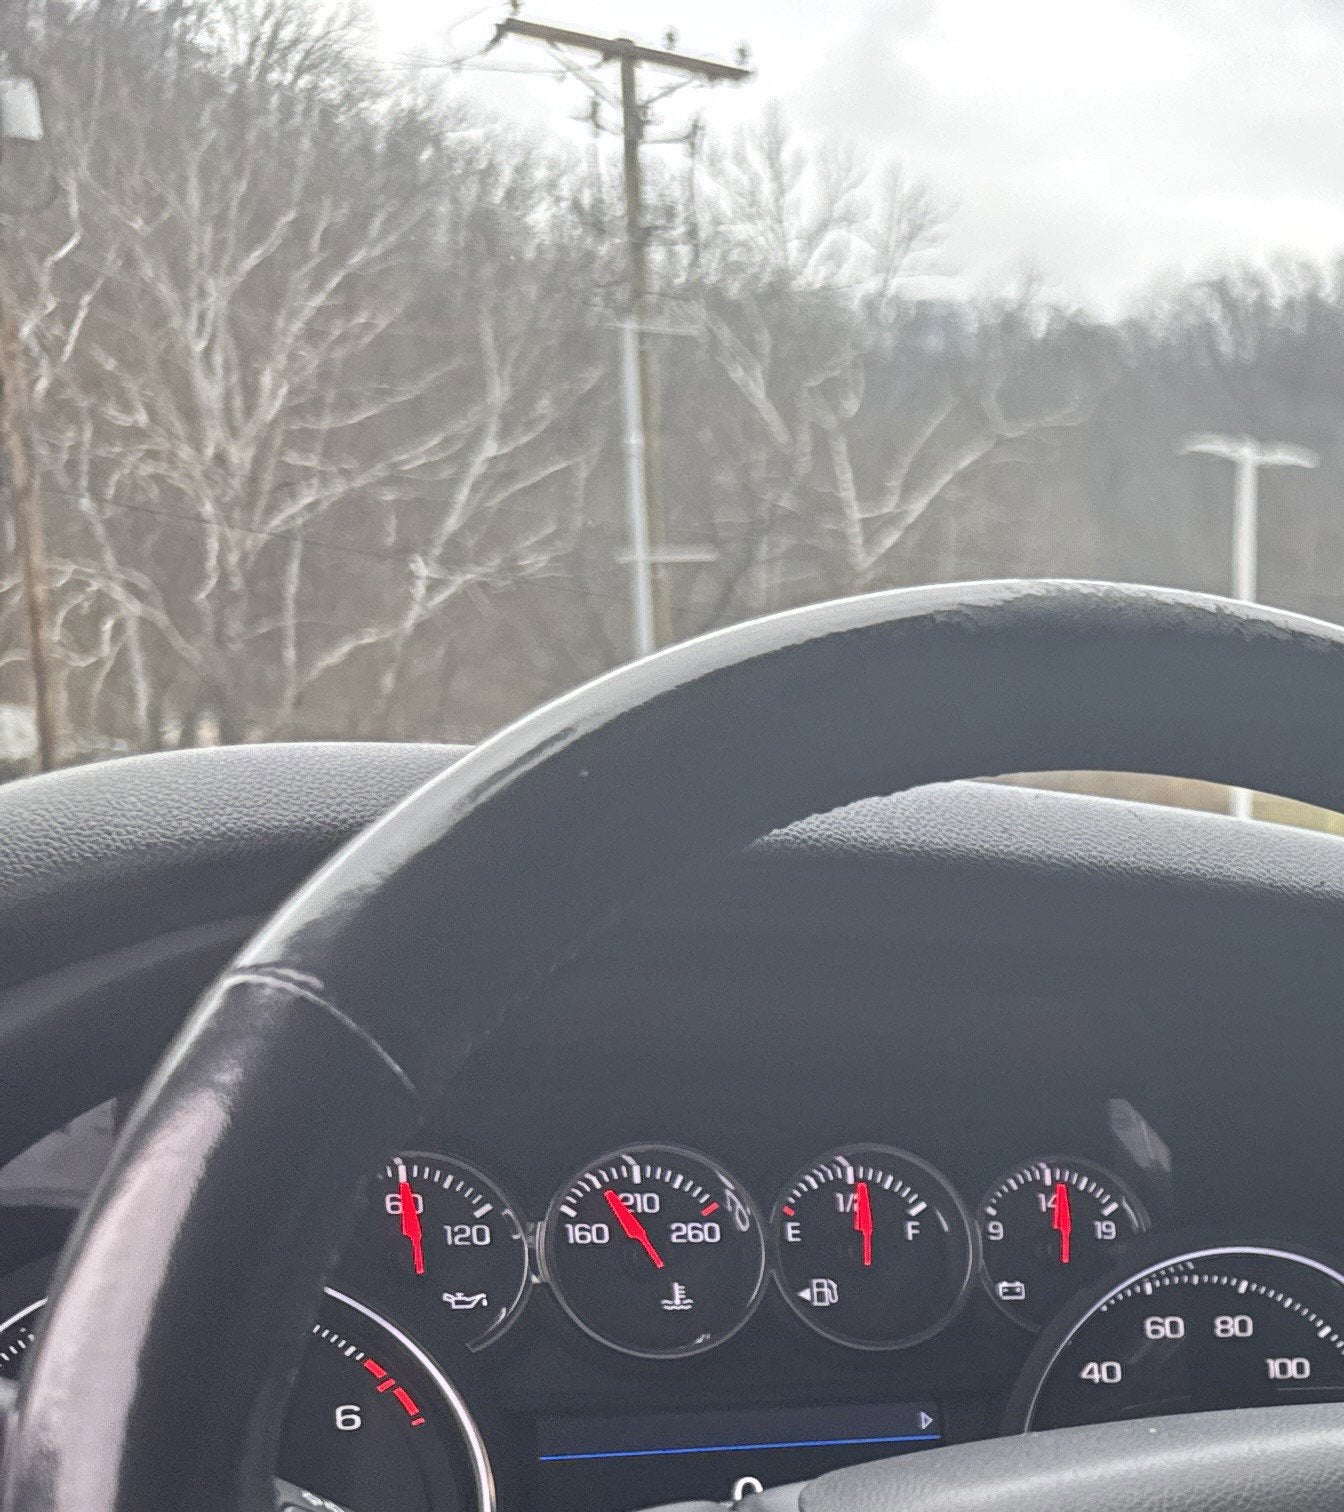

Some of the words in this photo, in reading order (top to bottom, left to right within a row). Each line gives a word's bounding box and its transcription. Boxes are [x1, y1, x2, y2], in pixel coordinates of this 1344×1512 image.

[617, 1192, 660, 1214] 210
[443, 1224, 491, 1246] 120
[565, 1223, 609, 1244] 160
[670, 1222, 721, 1243] 260
[785, 1221, 801, 1242] E
[906, 1220, 920, 1241] F
[987, 1220, 1004, 1241] 9
[1094, 1220, 1117, 1240] 19
[1143, 1316, 1185, 1339] 60
[1214, 1315, 1254, 1338] 80
[1080, 1361, 1123, 1384] 40
[1265, 1357, 1311, 1380] 100
[335, 1404, 362, 1431] 6
